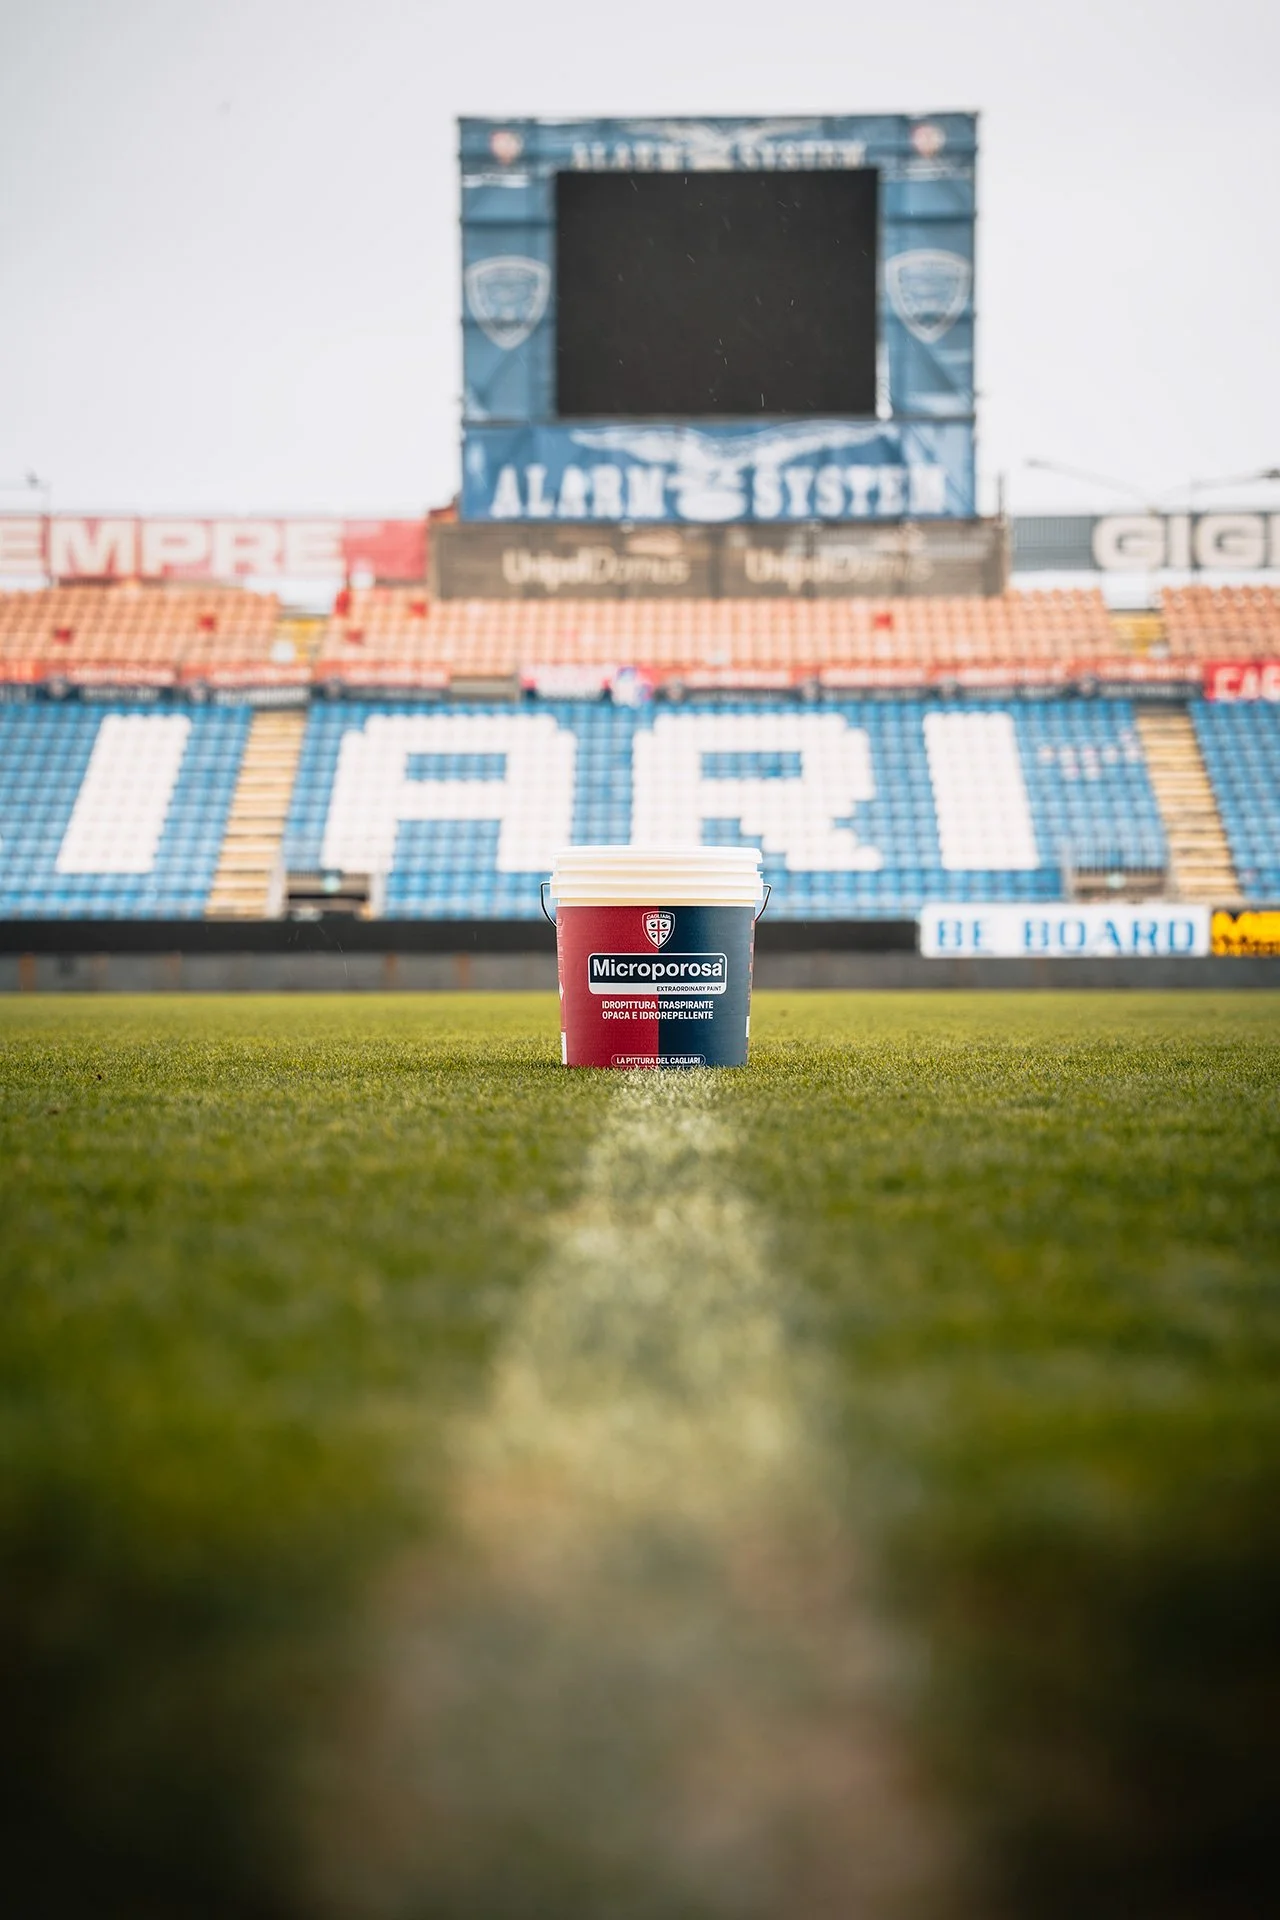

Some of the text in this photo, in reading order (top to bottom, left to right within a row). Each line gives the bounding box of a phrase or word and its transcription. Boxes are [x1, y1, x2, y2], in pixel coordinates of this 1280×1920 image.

[490, 463, 947, 519] ALARM SYSTEM
[938, 920, 1196, 947] BE BOARD
[592, 958, 723, 980] Microporosa
[602, 1001, 714, 1009] IDROPITTURA TRASPIRANTE
[602, 1011, 713, 1019] OPACA E IDROREPELLENTE
